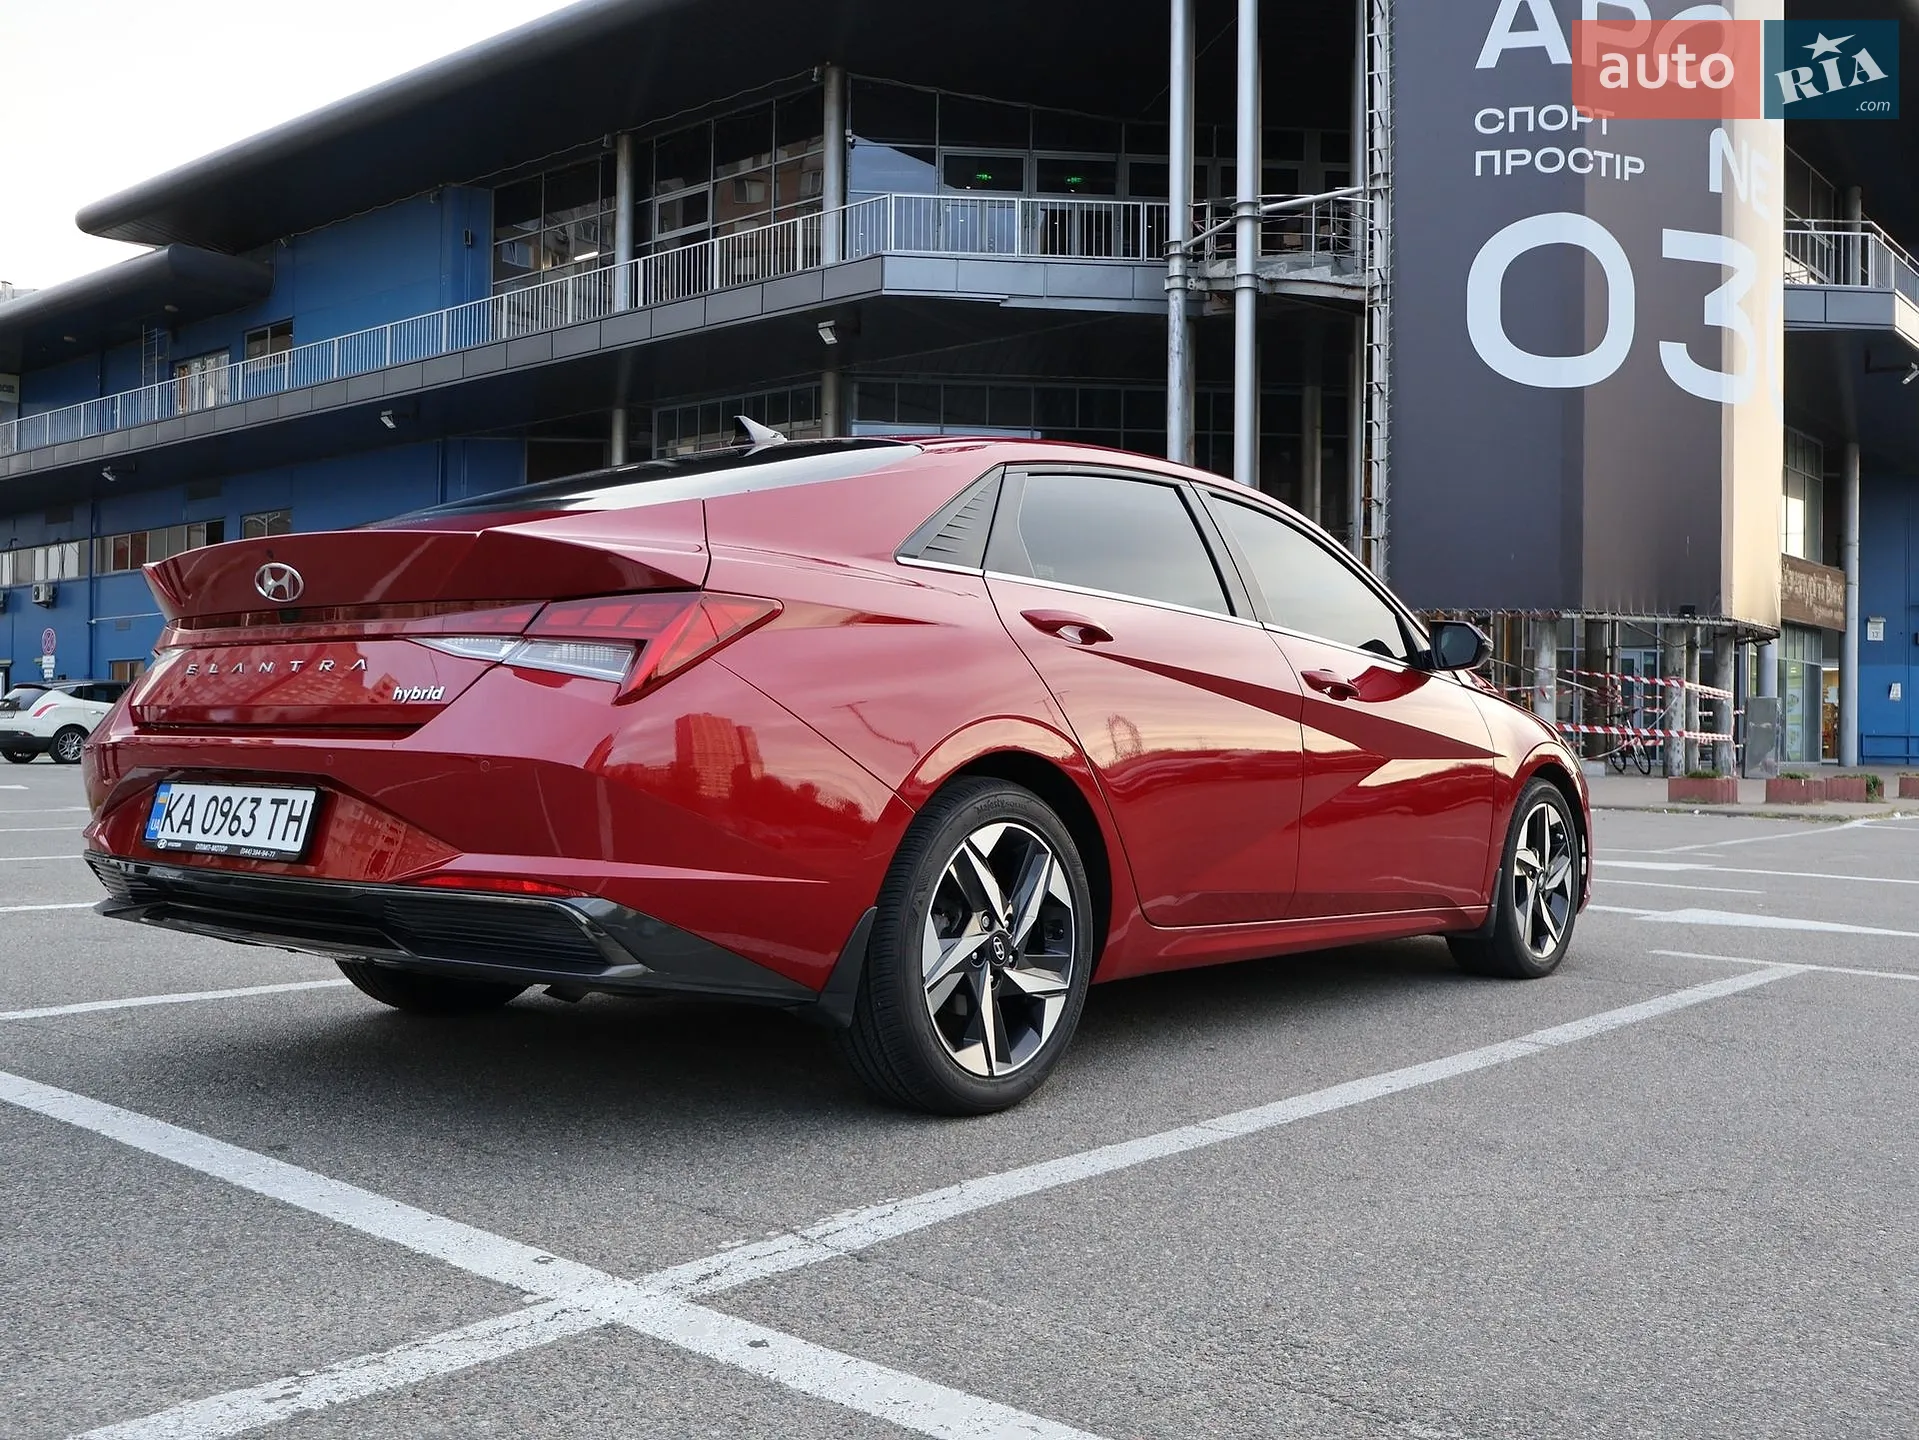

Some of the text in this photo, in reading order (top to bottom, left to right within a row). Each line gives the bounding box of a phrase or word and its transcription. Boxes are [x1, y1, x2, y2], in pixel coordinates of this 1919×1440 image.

[1474, 104, 1615, 136] СПОРТ
[1474, 147, 1645, 181] ПРОСТІР
[186, 658, 368, 675] ELANTRA
[392, 686, 445, 704] hybrid
[150, 818, 160, 831] UA
[161, 793, 308, 842] KA 0963 TH
